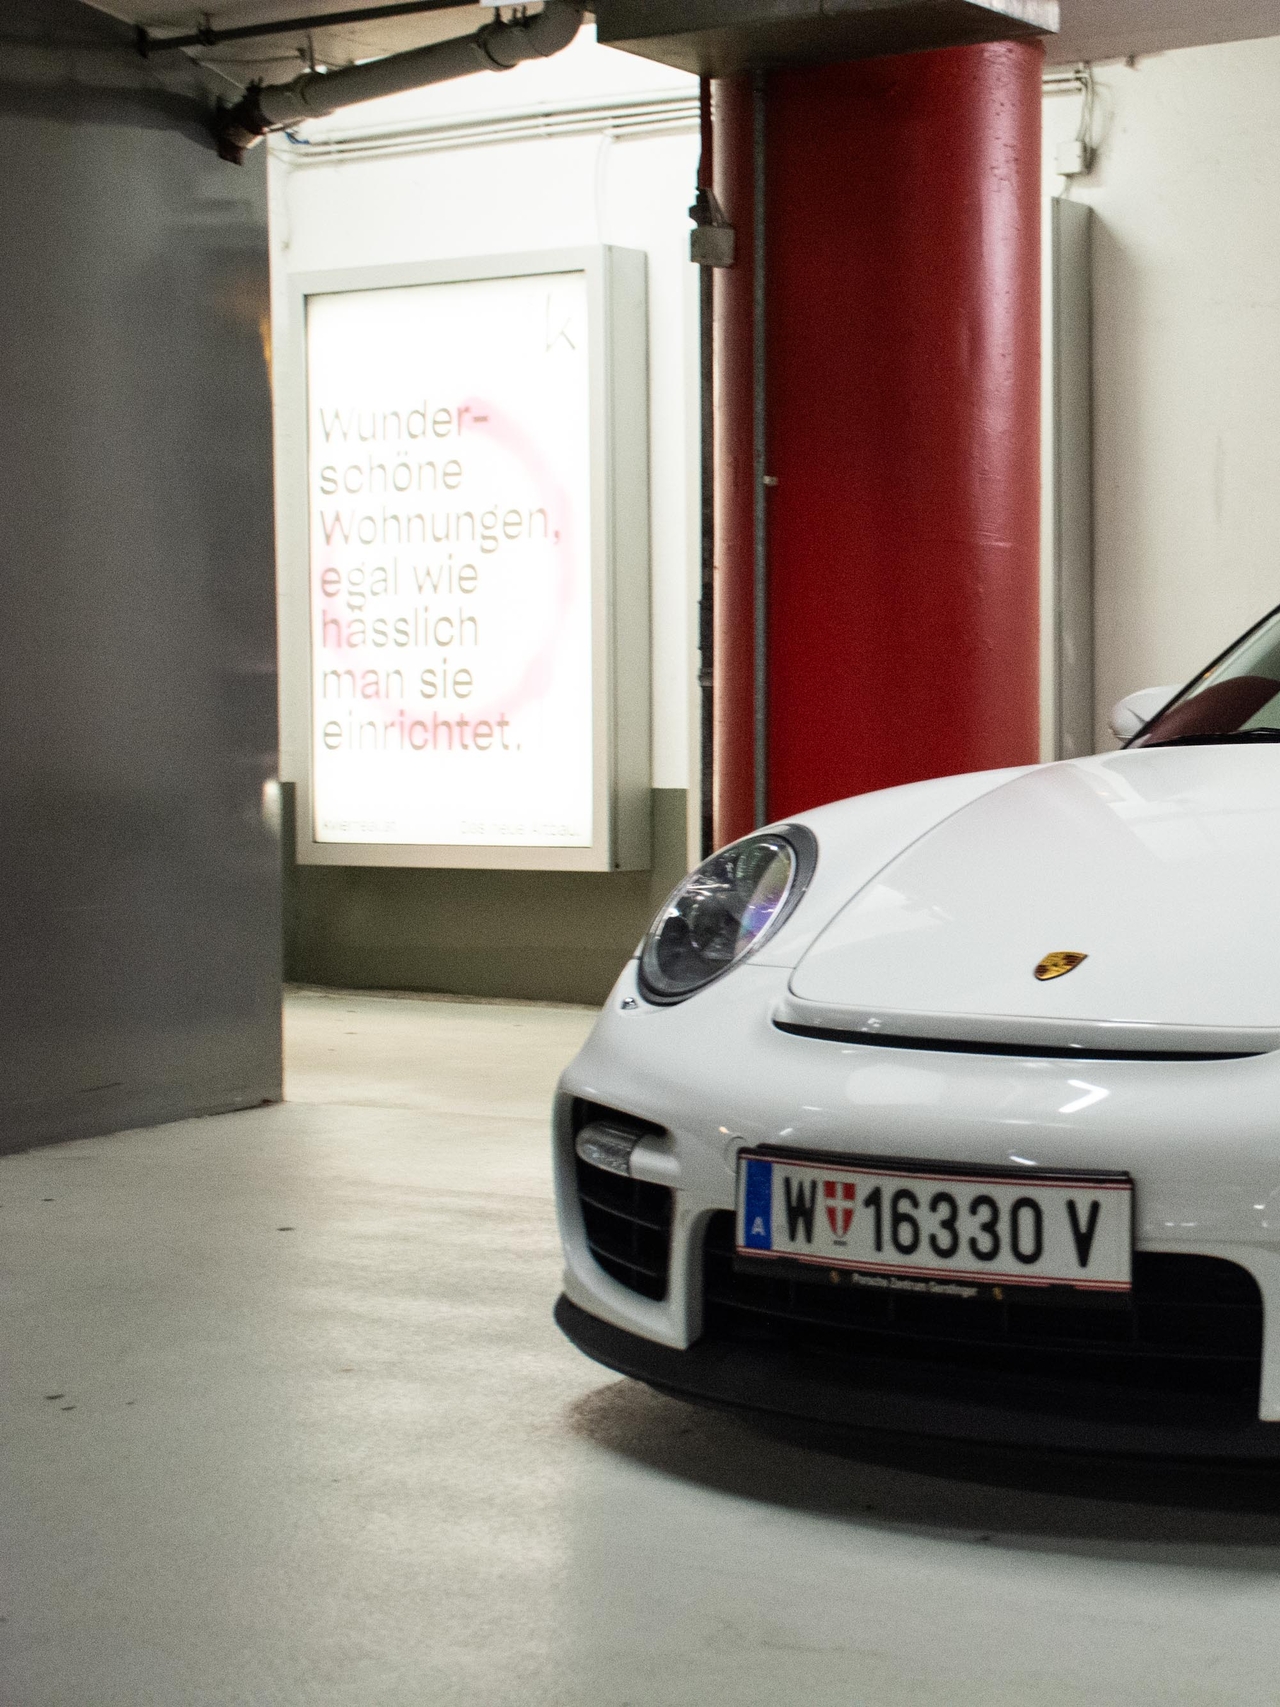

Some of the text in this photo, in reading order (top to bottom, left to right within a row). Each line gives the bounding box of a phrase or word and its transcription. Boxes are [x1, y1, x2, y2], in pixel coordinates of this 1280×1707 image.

[319, 398, 490, 443] Wunder-
[319, 450, 463, 496] schöne
[319, 504, 562, 554] Wohnungen,
[320, 553, 478, 611] egal wie
[322, 657, 474, 700] man sie
[322, 709, 522, 751] einrichtet.
[752, 1176, 1100, 1268] A W 16330 V
